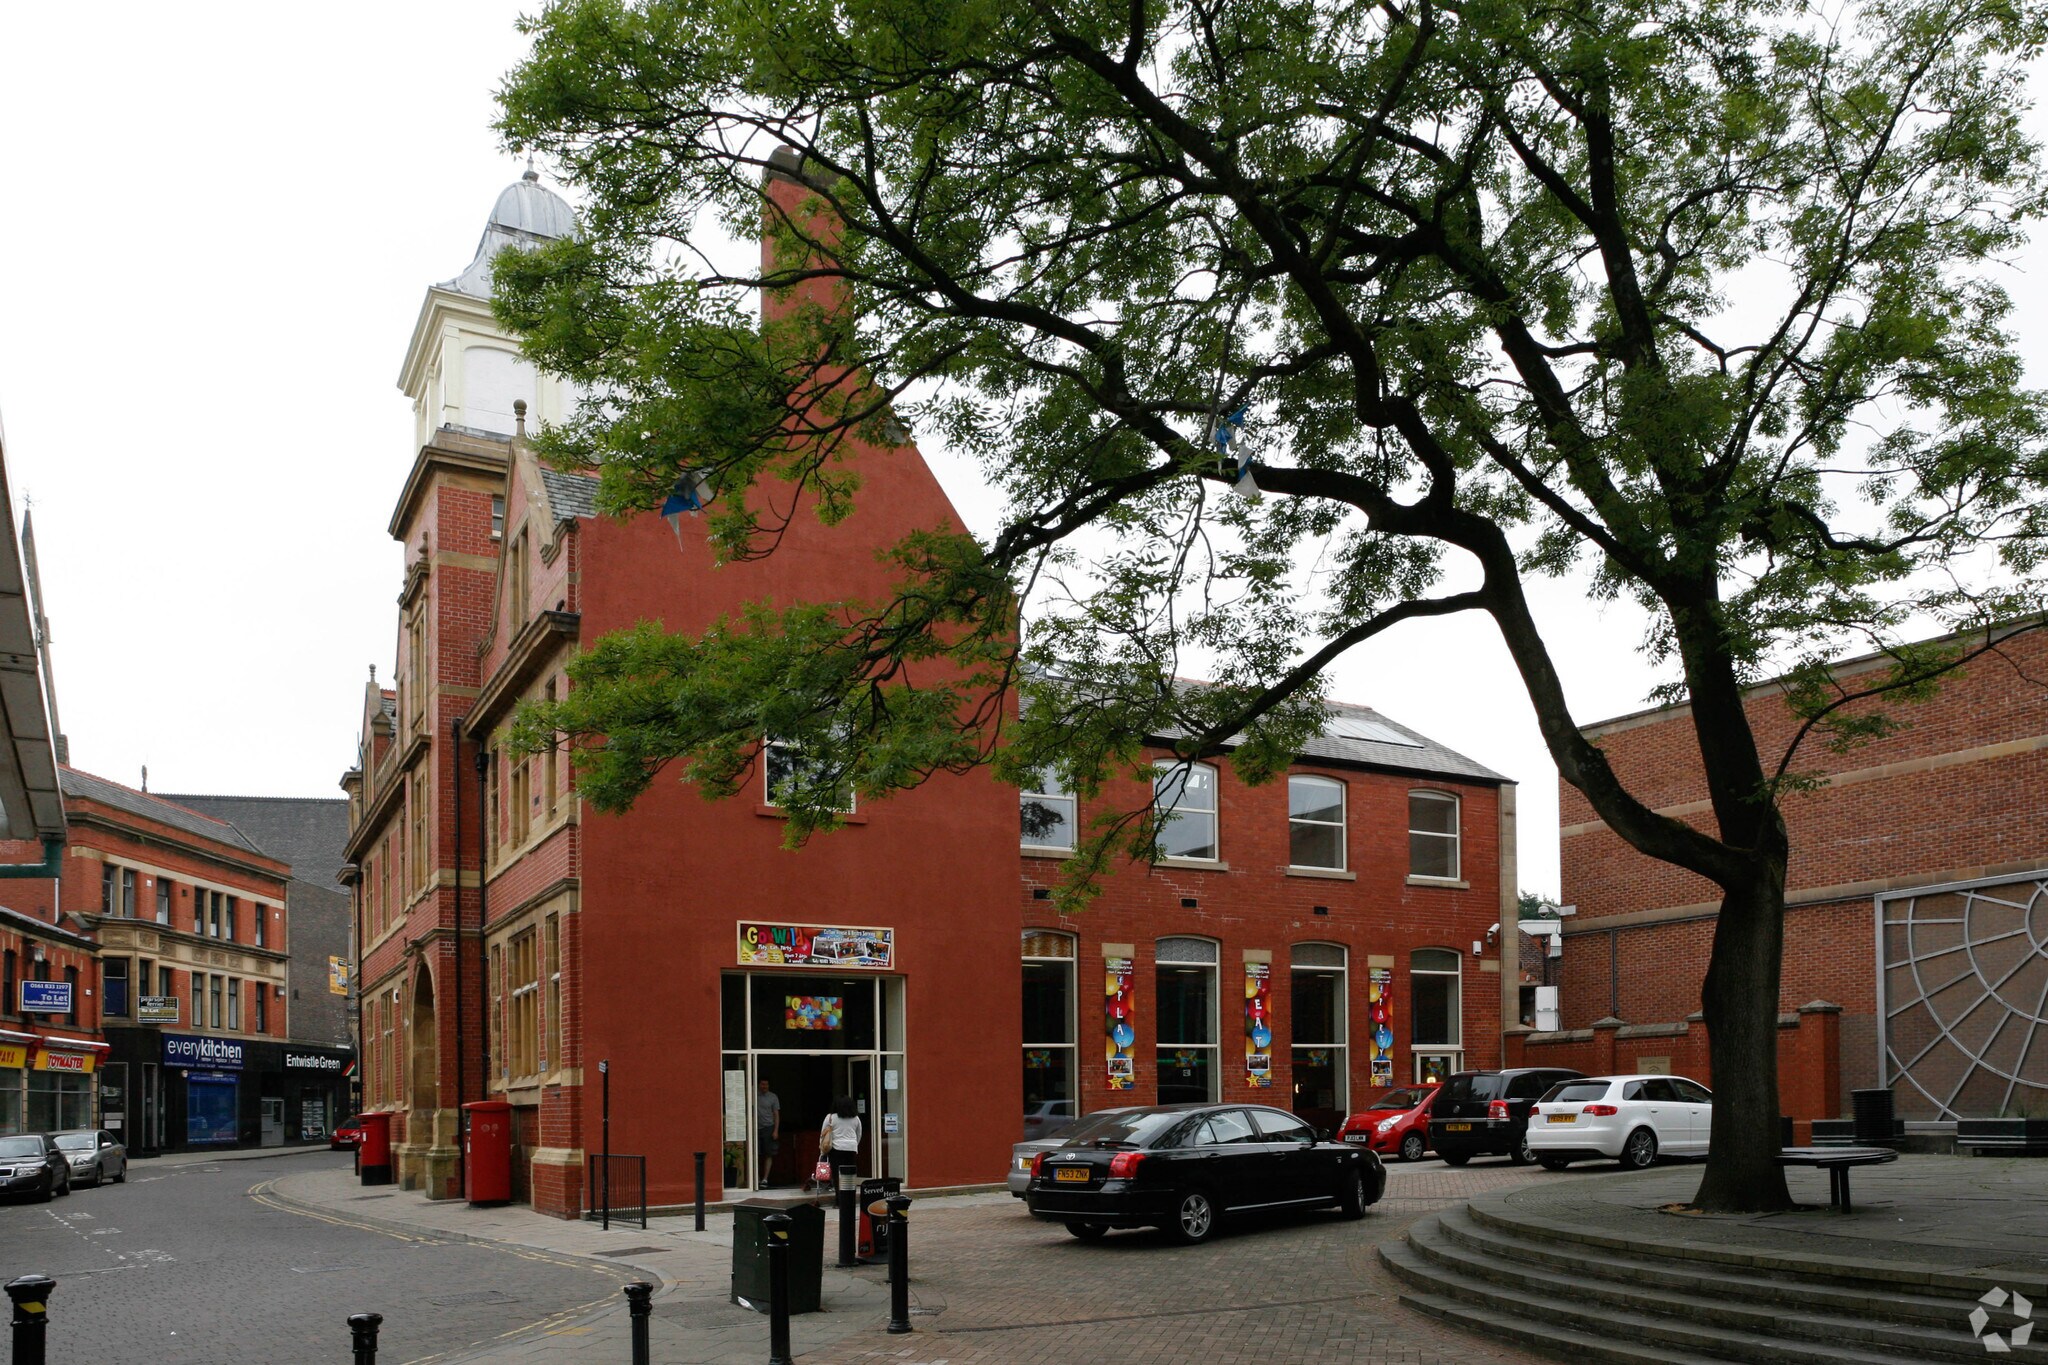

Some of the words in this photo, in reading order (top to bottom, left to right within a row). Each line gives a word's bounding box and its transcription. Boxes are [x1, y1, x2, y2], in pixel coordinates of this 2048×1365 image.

[747, 926, 768, 944] Go
[54, 994, 68, 1002] Let
[1116, 990, 1124, 1053] PLAY
[1254, 999, 1263, 1048] EAT
[168, 1039, 242, 1060] everykitchen
[48, 1054, 84, 1069] TOYMASTER
[286, 1054, 319, 1068] Entwistle
[320, 1056, 340, 1069] Green
[1058, 1169, 1073, 1179] FN53
[1076, 1169, 1088, 1179] ZNK
[864, 1186, 883, 1194] Served
